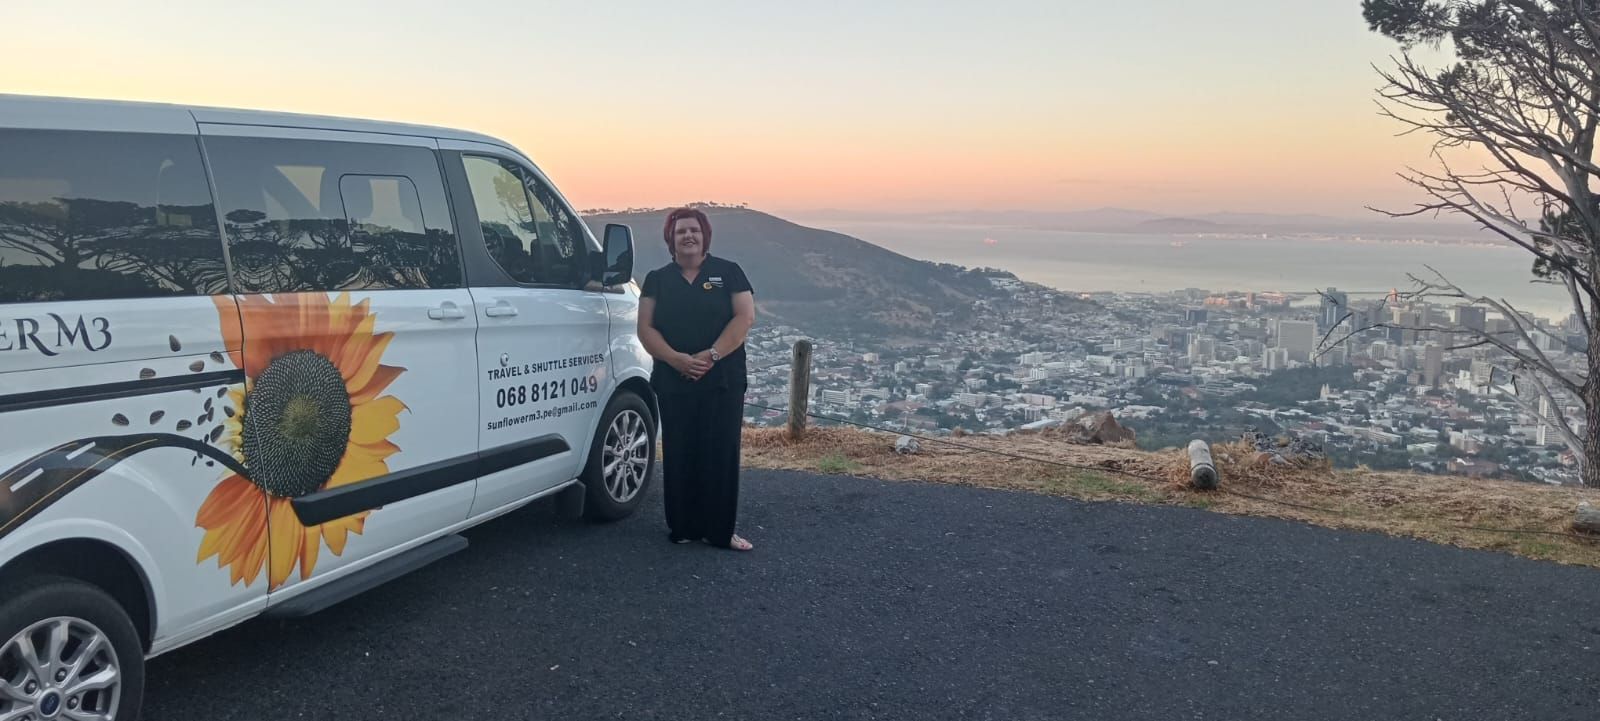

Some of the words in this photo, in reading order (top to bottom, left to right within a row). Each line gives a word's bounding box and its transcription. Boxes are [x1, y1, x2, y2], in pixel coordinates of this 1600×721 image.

[487, 366, 522, 381] TRAVEL
[524, 364, 531, 375] &
[531, 358, 567, 373] SHUTTLE
[568, 353, 604, 367] SERVICES
[496, 385, 527, 408] 068
[531, 379, 566, 402] 8121
[571, 375, 597, 396] 049
[487, 400, 598, 430] sunflowerm3.pe@gmail.com
